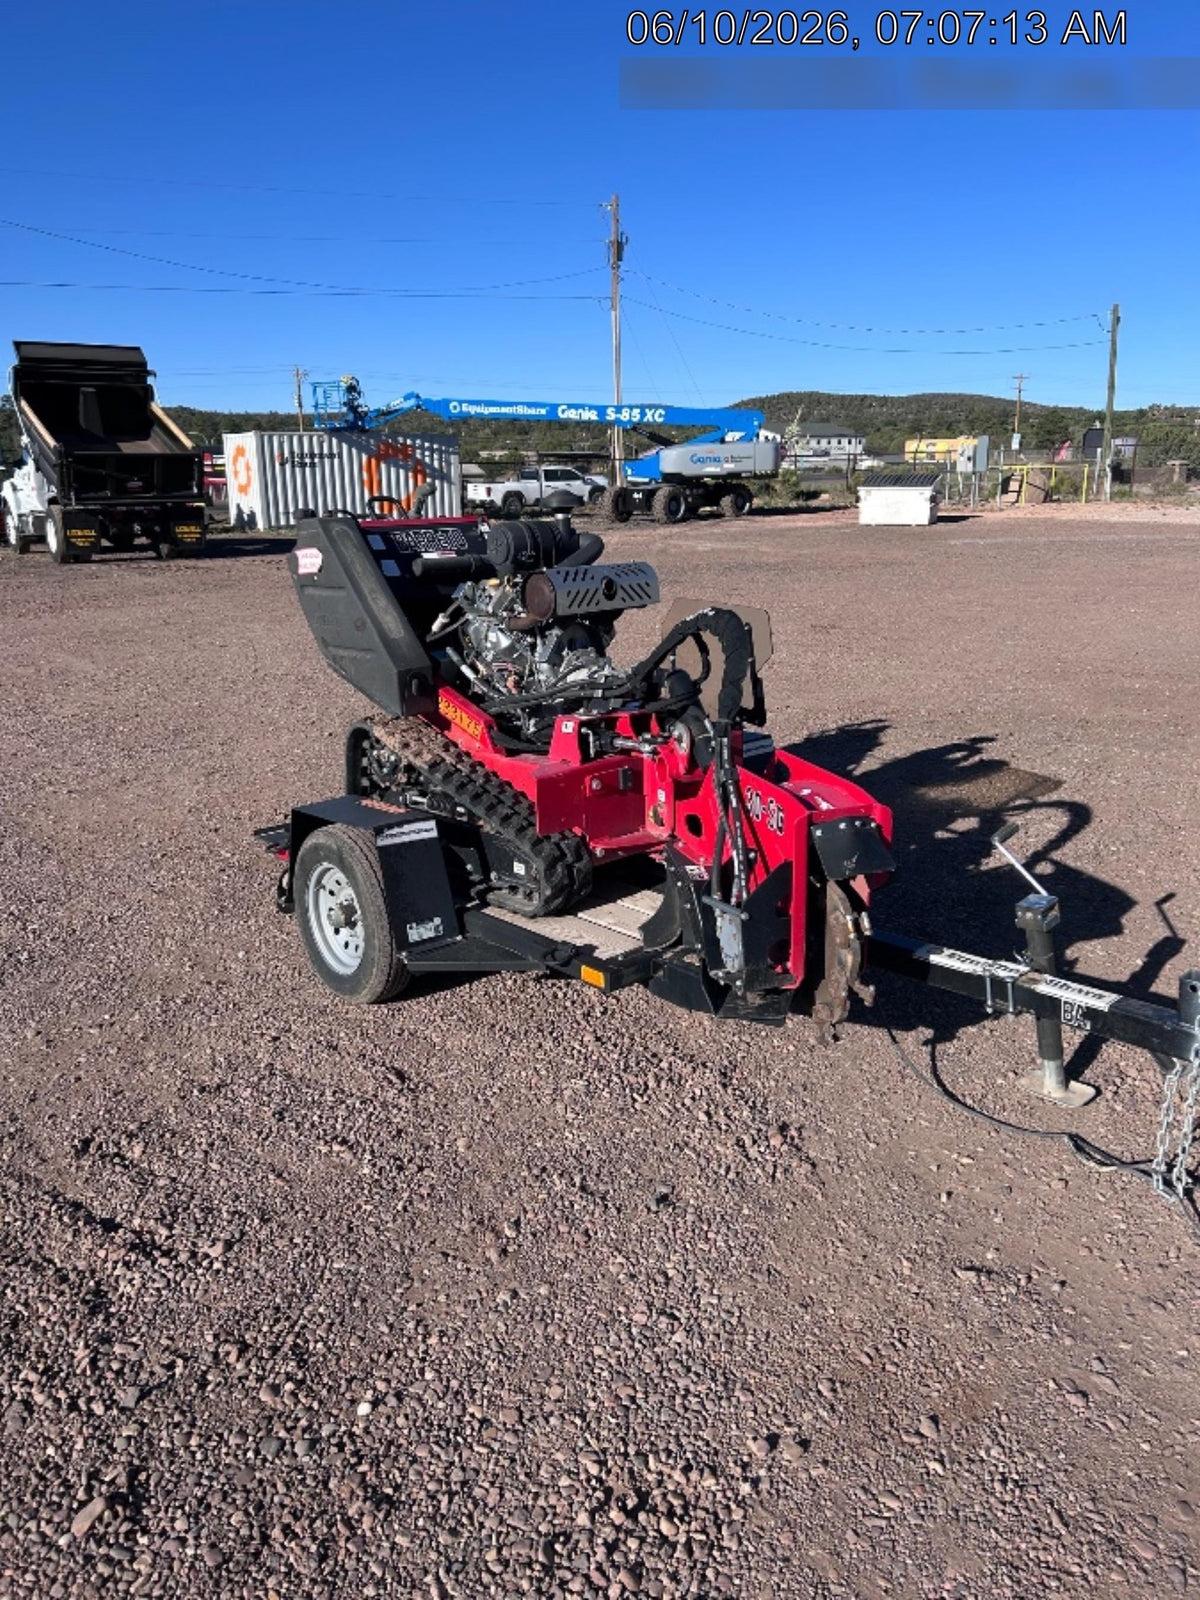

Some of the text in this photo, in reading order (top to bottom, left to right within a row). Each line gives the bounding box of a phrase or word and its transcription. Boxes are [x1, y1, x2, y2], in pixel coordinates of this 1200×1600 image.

[461, 402, 547, 415] EquipmentShare
[557, 404, 666, 423] Genie S-85 XC
[689, 453, 722, 465] Genie
